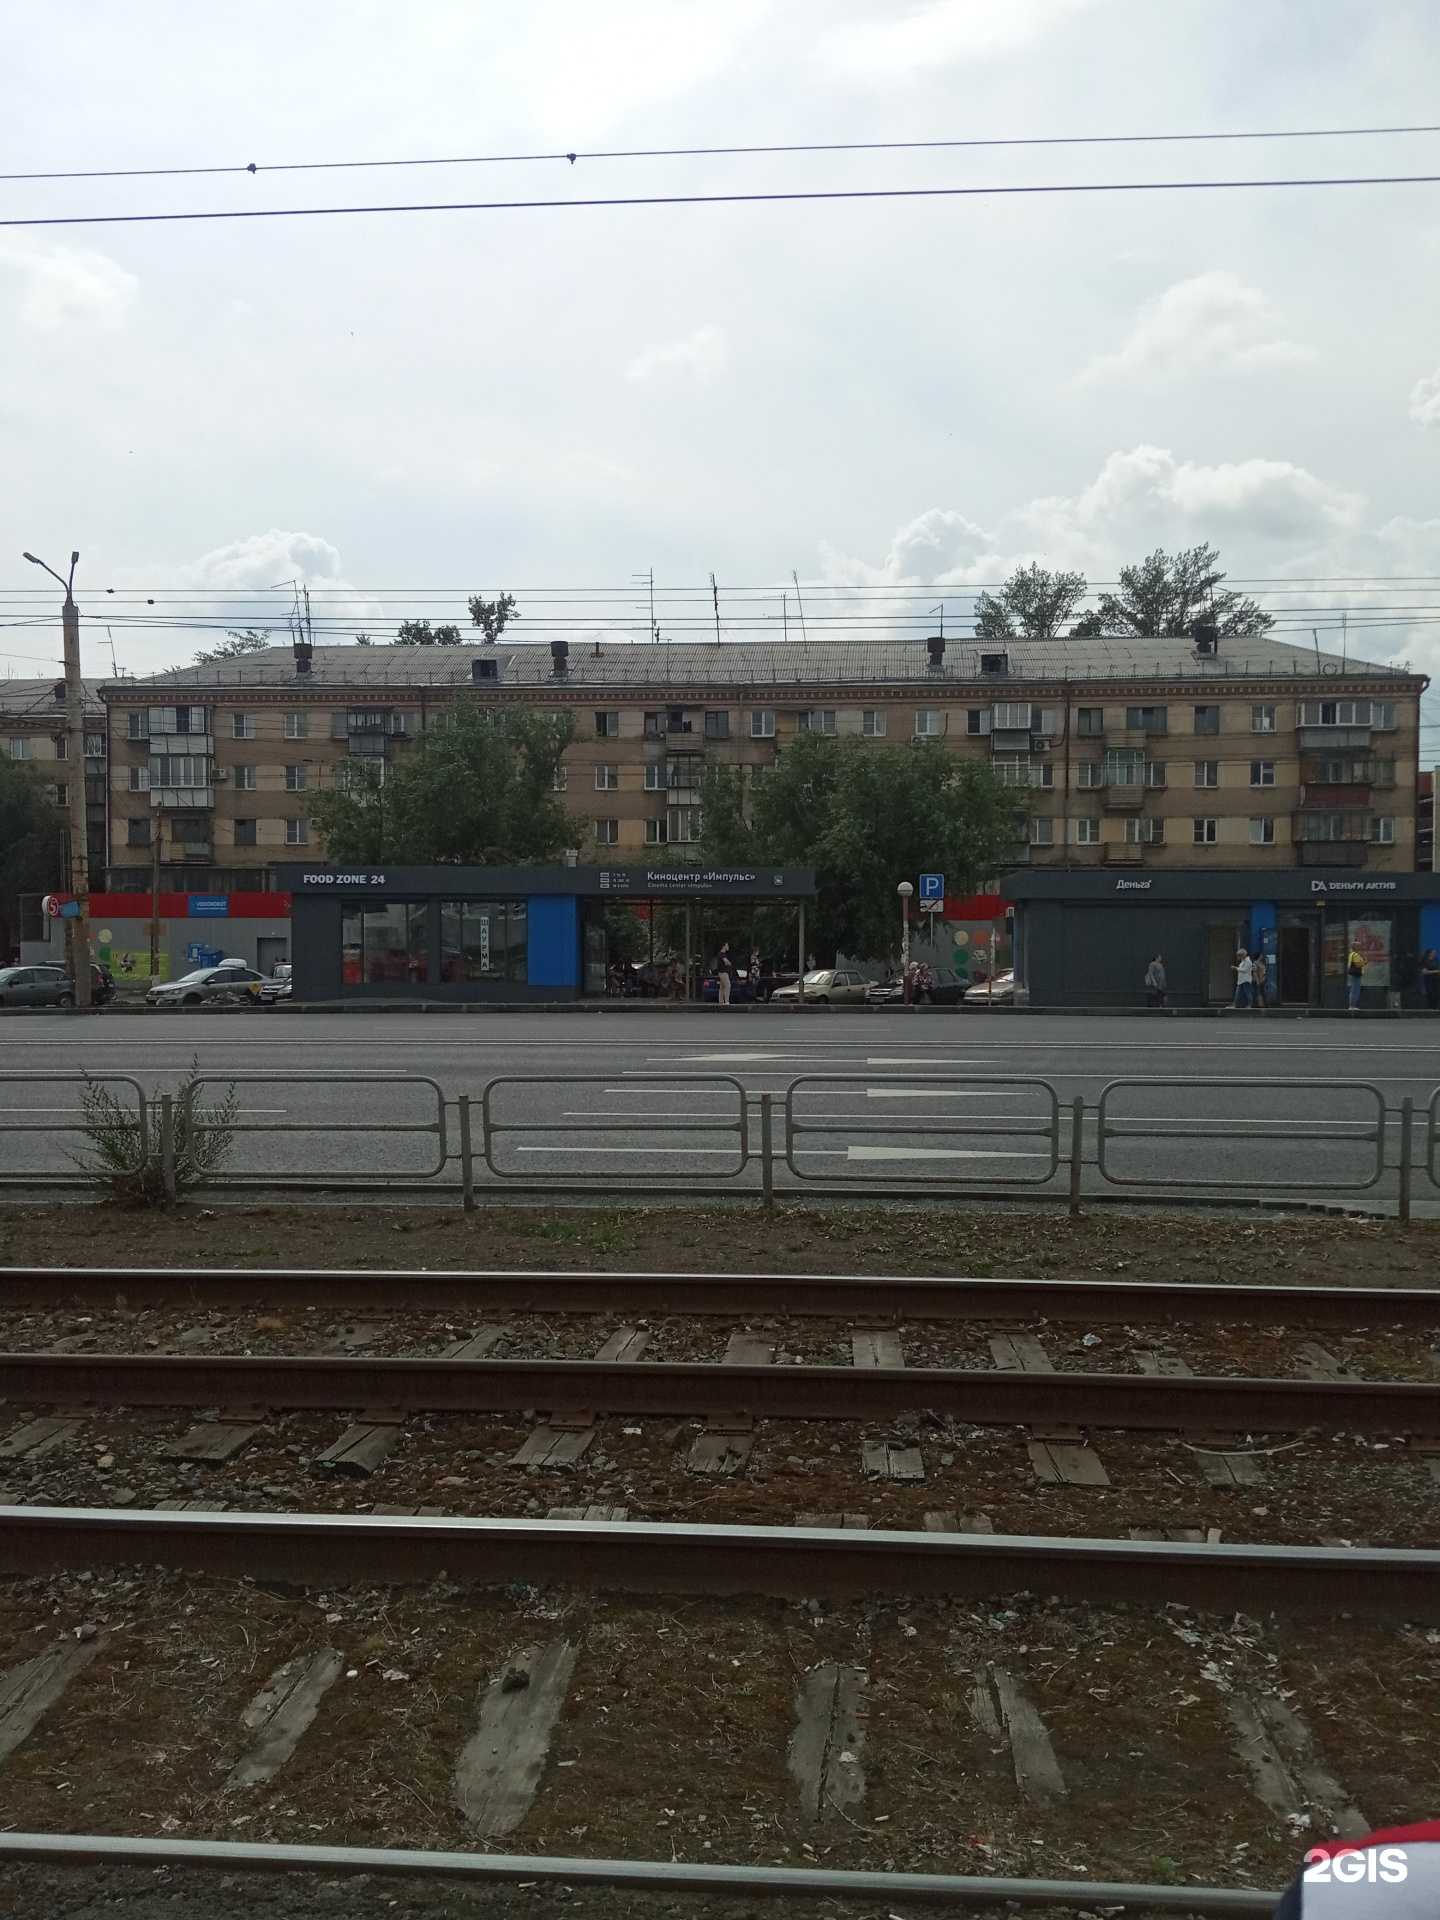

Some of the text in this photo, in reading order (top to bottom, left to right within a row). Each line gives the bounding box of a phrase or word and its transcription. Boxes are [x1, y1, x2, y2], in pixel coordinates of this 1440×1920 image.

[303, 874, 386, 884] FOOD ZONE 24
[647, 871, 755, 882] Киноцентр «Импульс»
[481, 918, 489, 969] ШАУРМА
